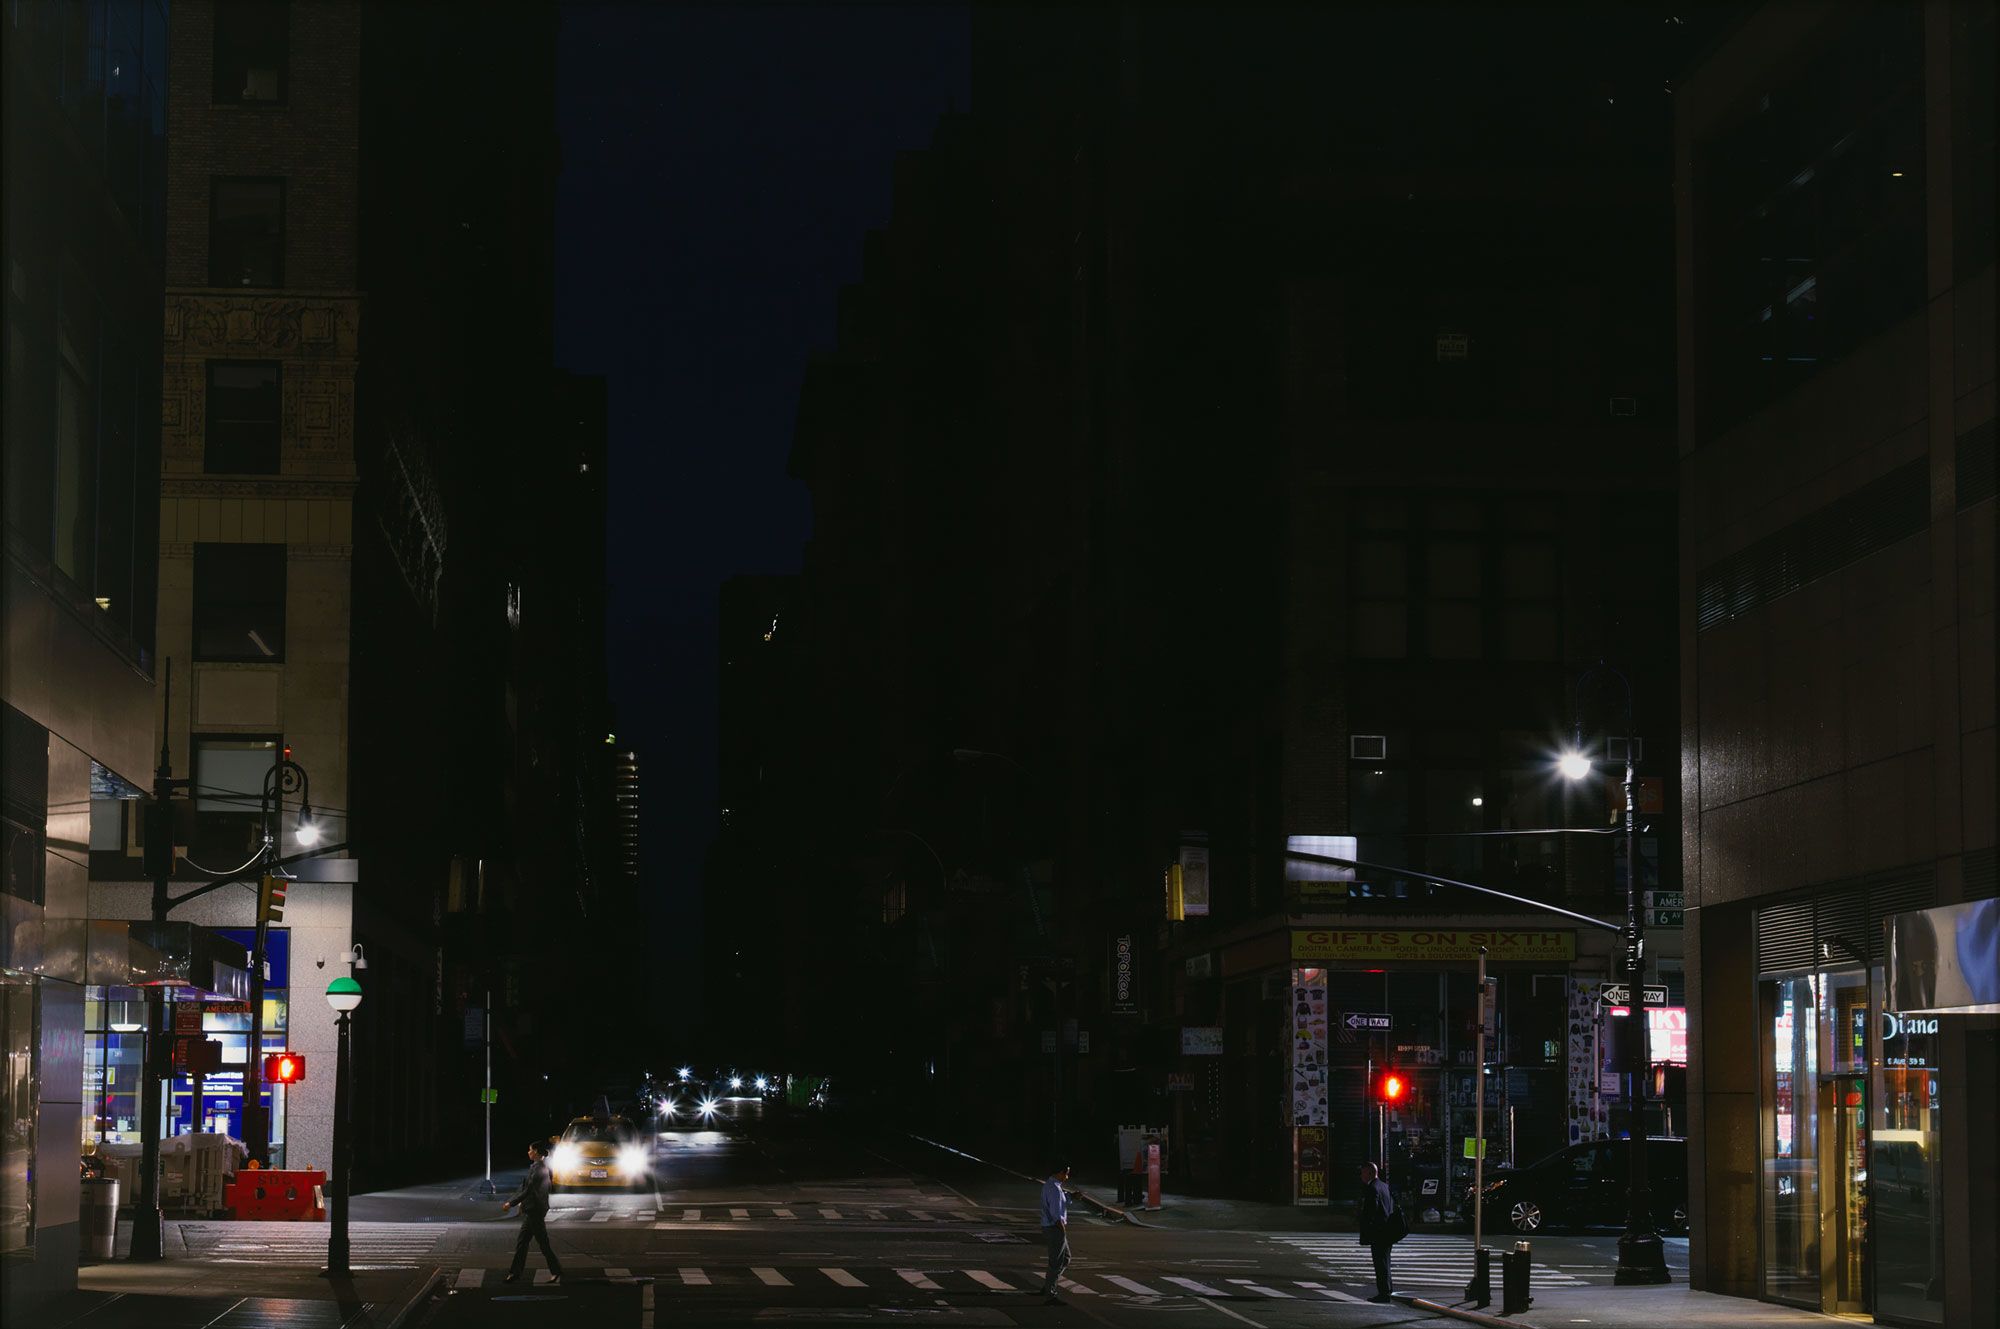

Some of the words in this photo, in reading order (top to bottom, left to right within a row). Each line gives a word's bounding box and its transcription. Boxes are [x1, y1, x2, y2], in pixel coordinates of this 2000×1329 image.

[1660, 911, 1668, 924] 6
[1306, 932, 1400, 945] GIFTS
[1411, 932, 1457, 945] ON
[1468, 933, 1562, 945] SIXTH
[1297, 945, 1332, 953] DIGITAL
[1336, 945, 1383, 953] CAMERAS
[1607, 991, 1629, 1001] ONE
[1302, 1172, 1324, 1182] BUY
[1301, 1187, 1325, 1196] HERE
